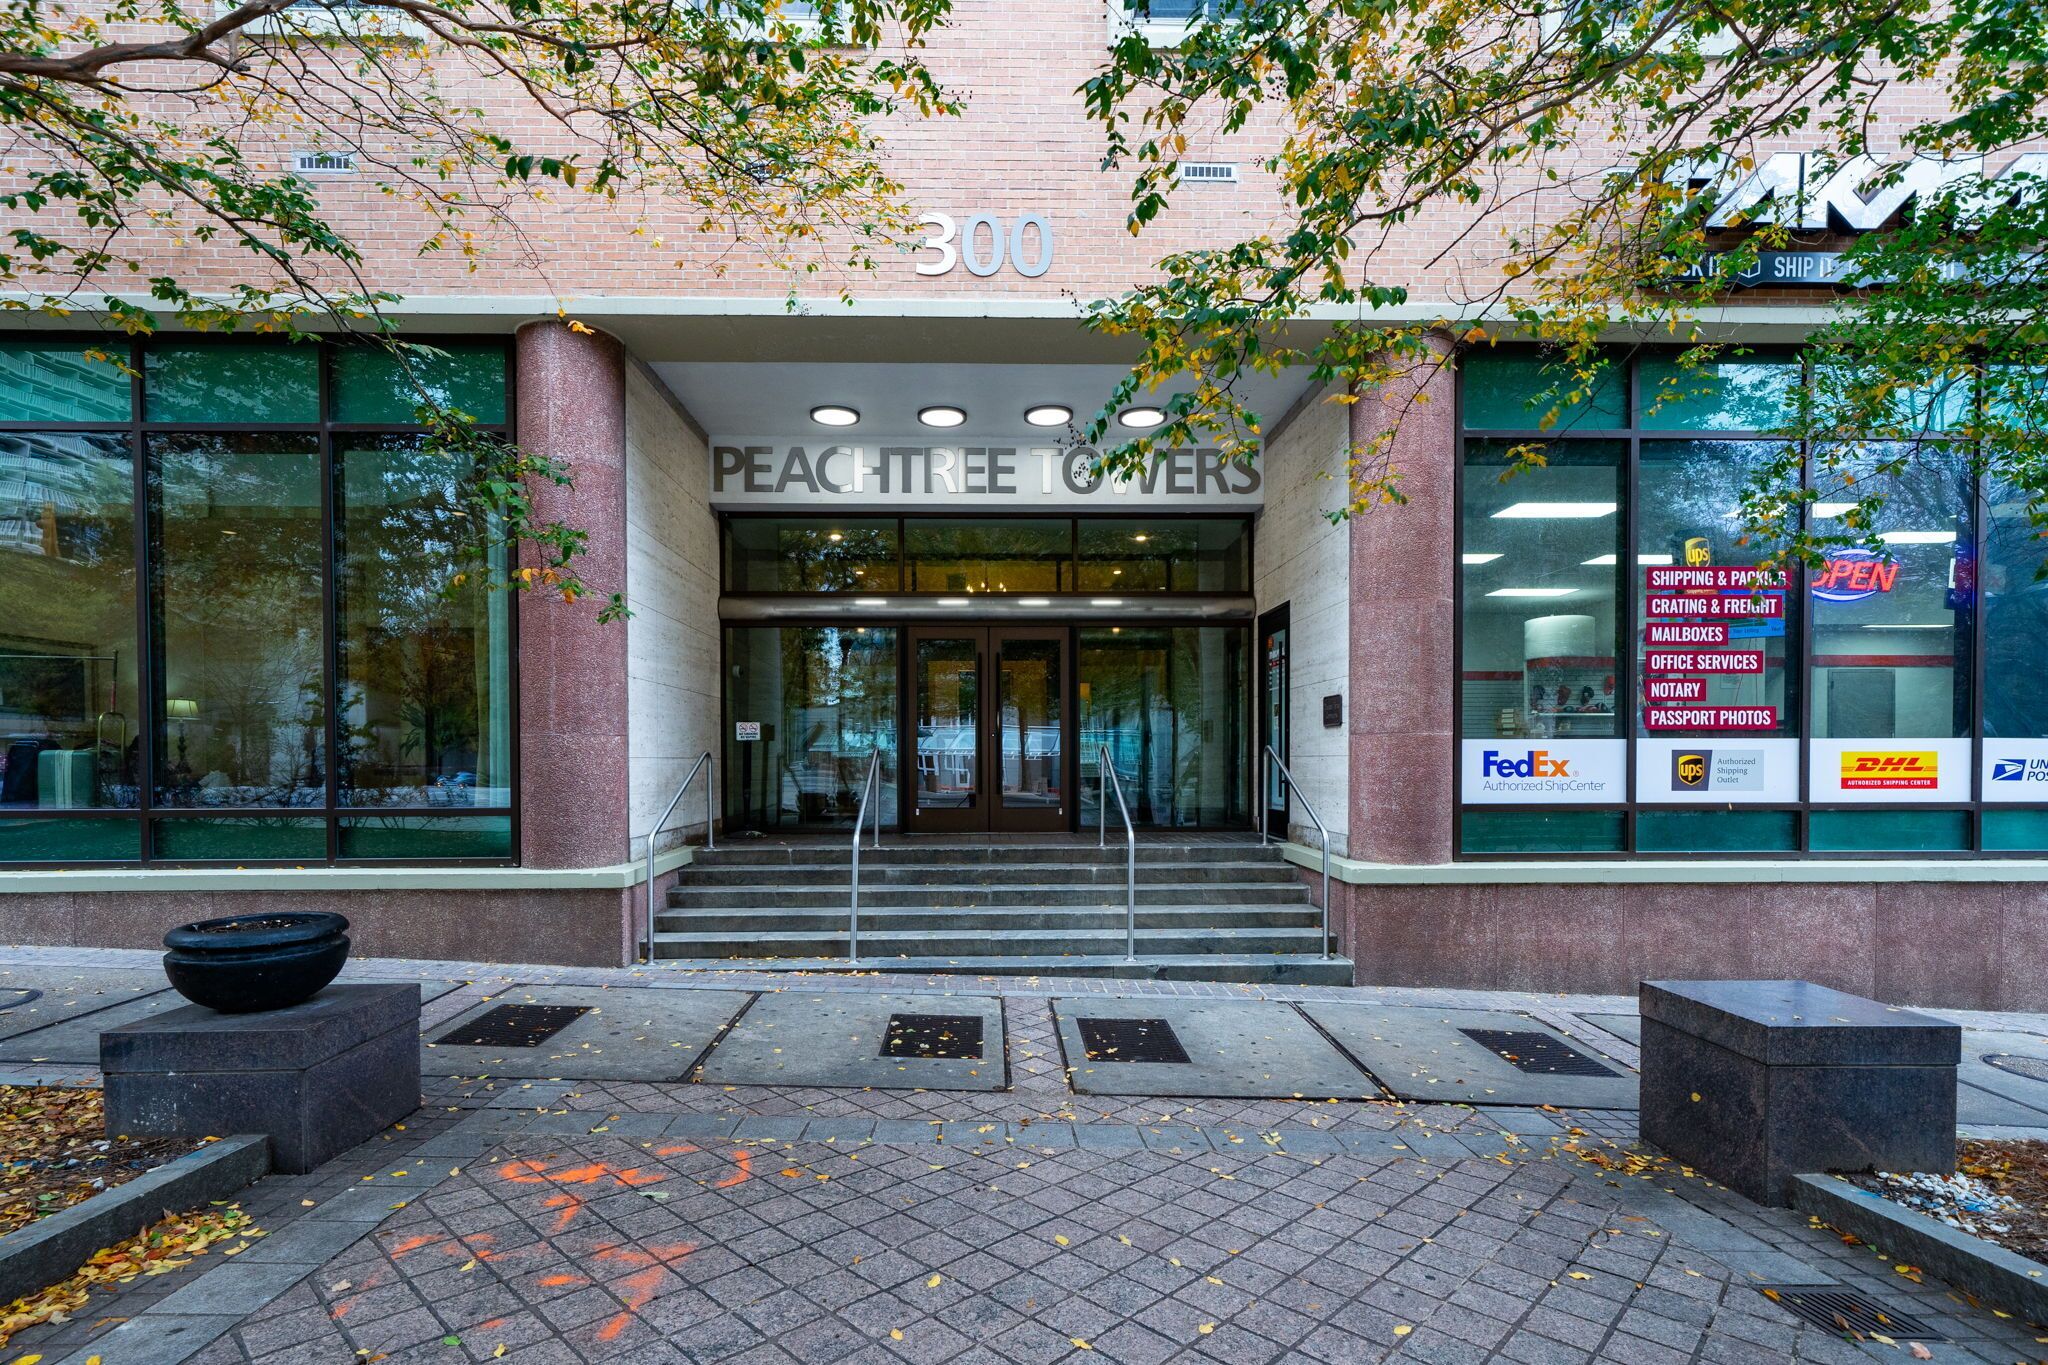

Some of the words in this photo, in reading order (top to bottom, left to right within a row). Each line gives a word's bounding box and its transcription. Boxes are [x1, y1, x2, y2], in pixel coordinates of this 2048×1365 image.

[915, 212, 1054, 278] 300
[1774, 256, 1814, 278] SHIP
[1819, 256, 1835, 278] IT
[712, 446, 1017, 494] PEACHTREE
[1029, 446, 1262, 495] TOWERS
[1688, 547, 1709, 567] ups
[1652, 570, 1716, 586] SHIPPING
[1717, 570, 1727, 586] &
[1652, 598, 1707, 614] CRATING
[1710, 598, 1720, 614] &
[1724, 598, 1777, 614] FREIGHT
[1651, 626, 1723, 642] MAILBOXES
[1651, 654, 1694, 670] OFFICE
[1697, 654, 1758, 670] SERVICES
[1651, 682, 1701, 698] NOTARY
[1650, 710, 1717, 726] PASSPORT
[1719, 710, 1771, 726] PHOTOS
[1483, 750, 1570, 778] FedEx
[1717, 767, 1748, 775] Shipping
[1854, 757, 1925, 772] DHL
[1680, 764, 1704, 781] ups
[2027, 771, 2048, 781] PO
[1483, 780, 1543, 791] Authorized
[1545, 780, 1606, 793] ShipCenter
